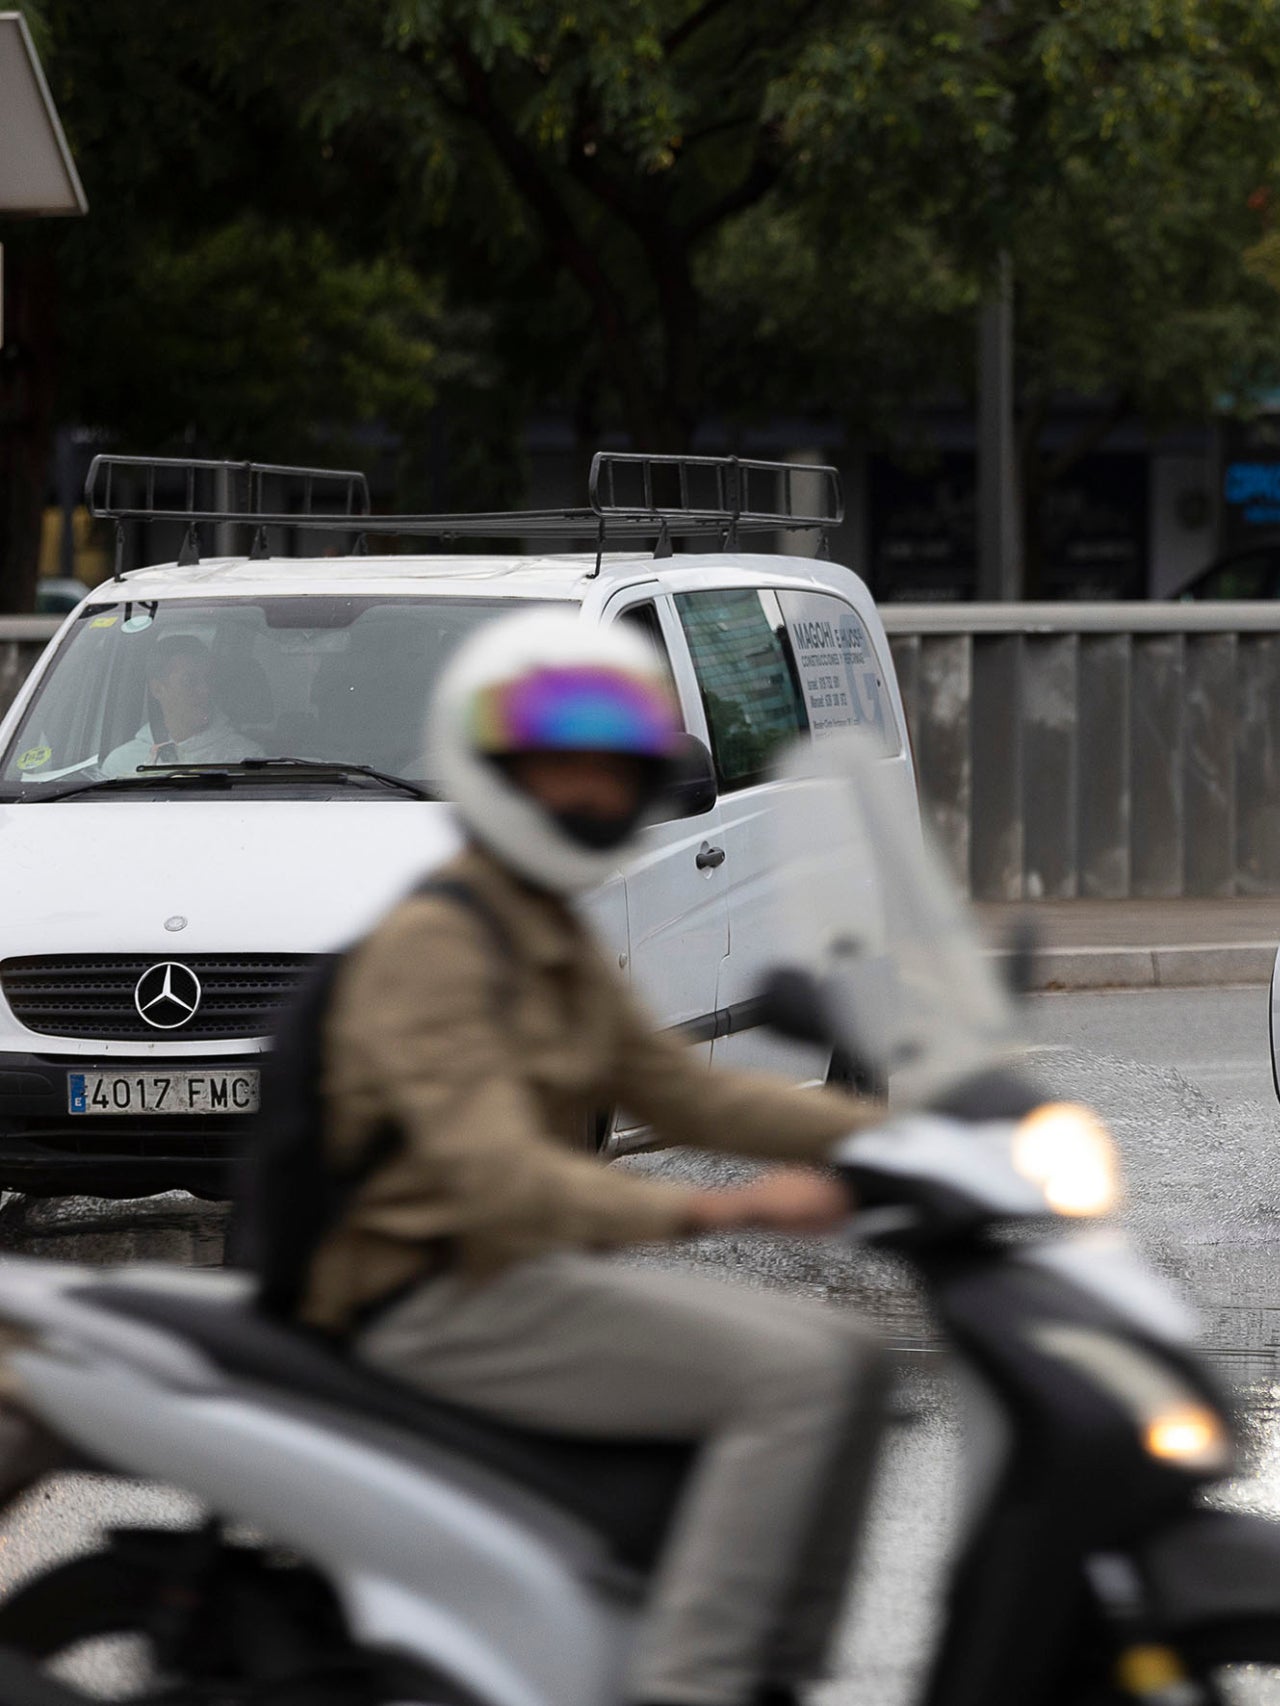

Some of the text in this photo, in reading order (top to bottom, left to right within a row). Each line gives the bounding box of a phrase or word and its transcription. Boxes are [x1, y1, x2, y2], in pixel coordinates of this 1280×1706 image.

[793, 621, 835, 650] MAGOHI
[74, 1097, 82, 1107] E
[91, 1077, 251, 1109] 4017 FMC
